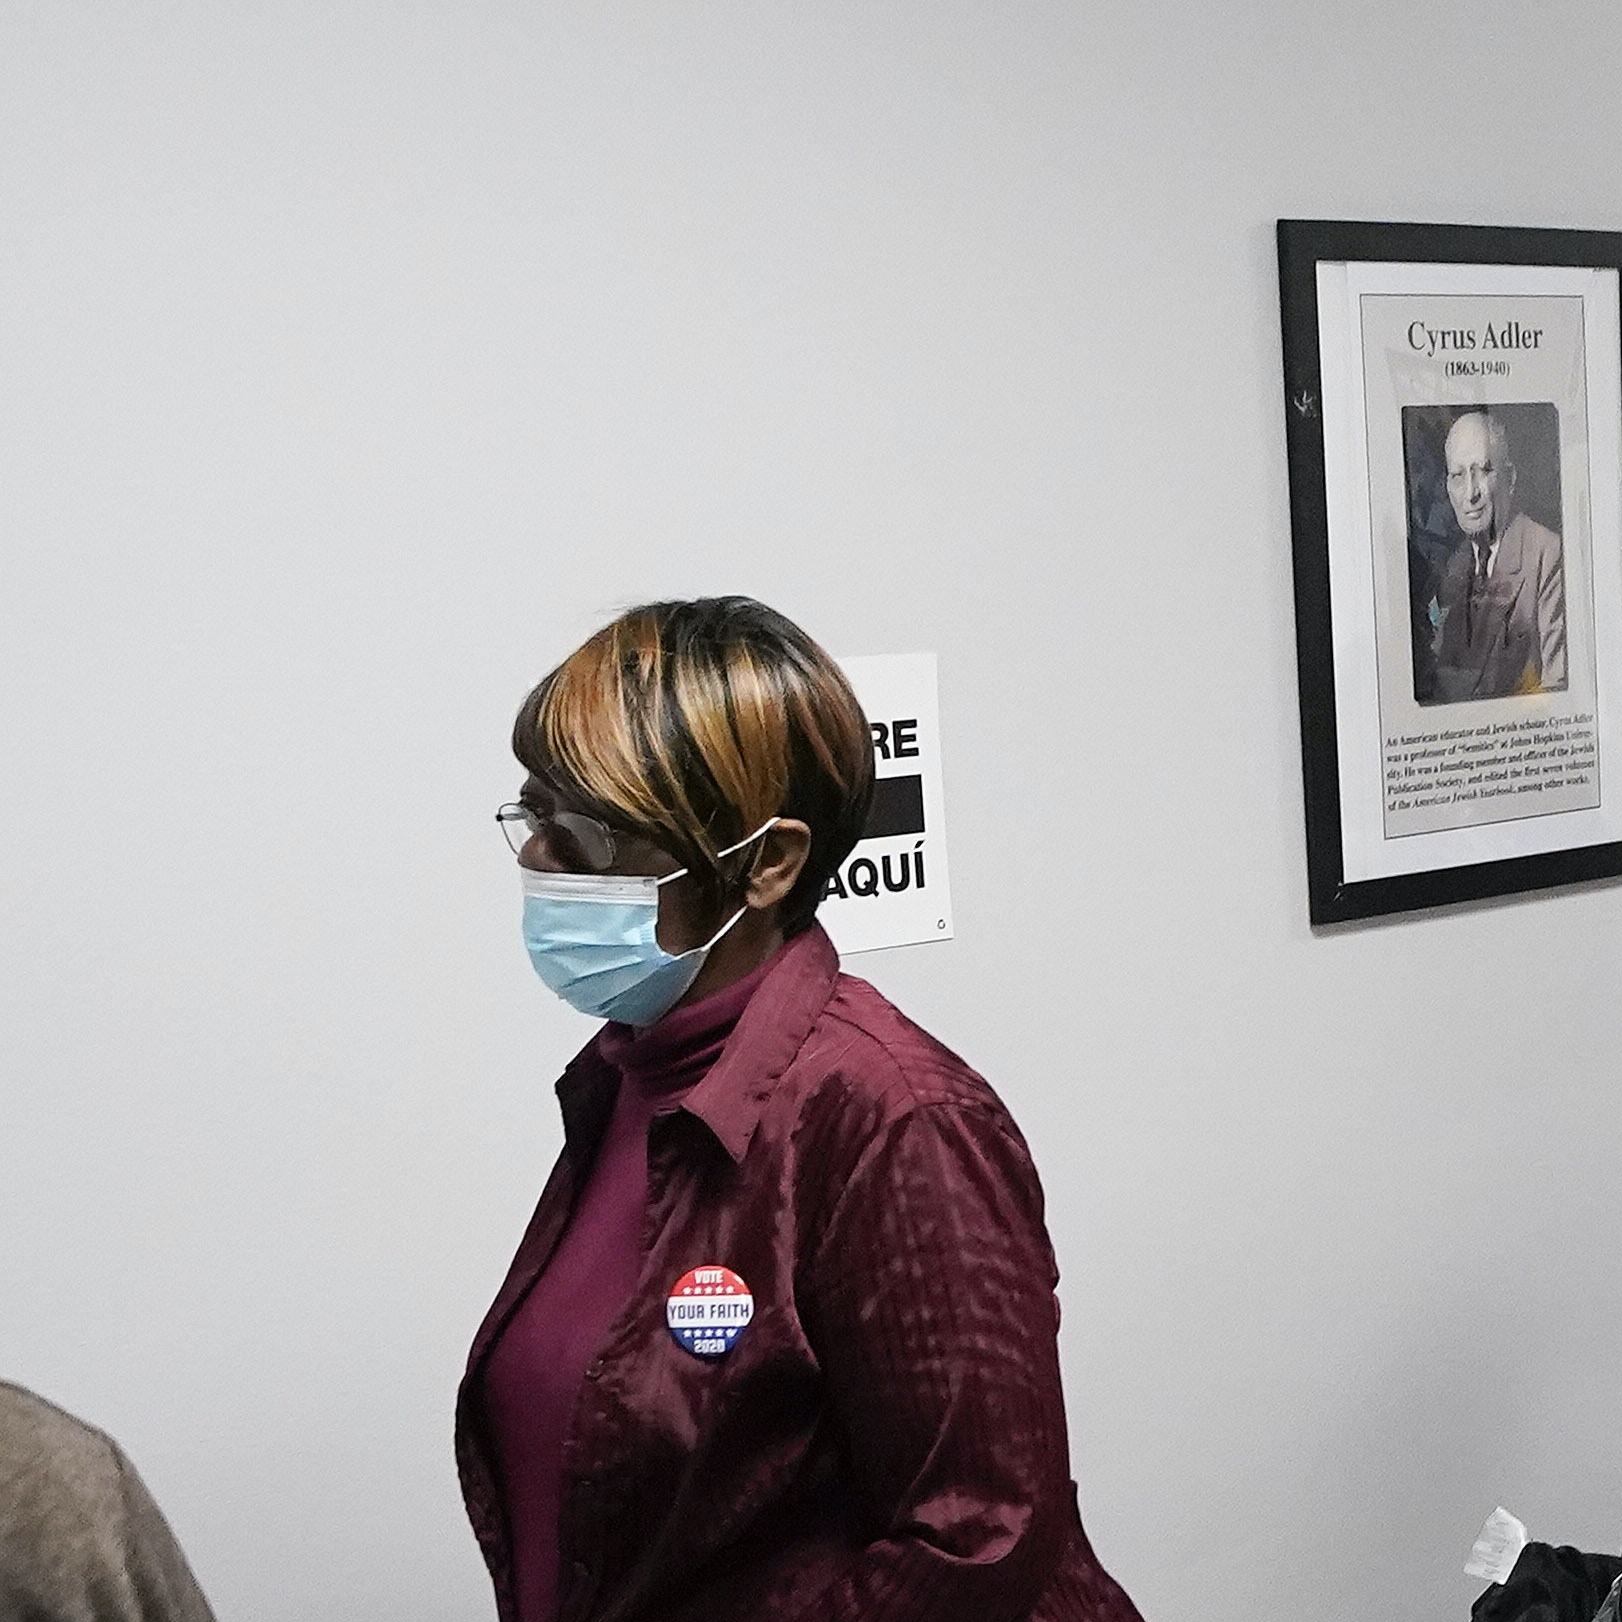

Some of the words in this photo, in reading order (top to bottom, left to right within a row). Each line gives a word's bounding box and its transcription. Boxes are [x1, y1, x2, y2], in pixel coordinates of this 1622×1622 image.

[1407, 320, 1477, 357] Cyrus
[1482, 321, 1544, 350] Adler
[1444, 360, 1511, 378] (1863-1940)
[821, 839, 926, 901] AQUÍ
[694, 1269, 724, 1285] VOTE
[669, 1303, 705, 1320] YOUR
[710, 1303, 750, 1319] FAITH
[693, 1338, 726, 1354] 2020
